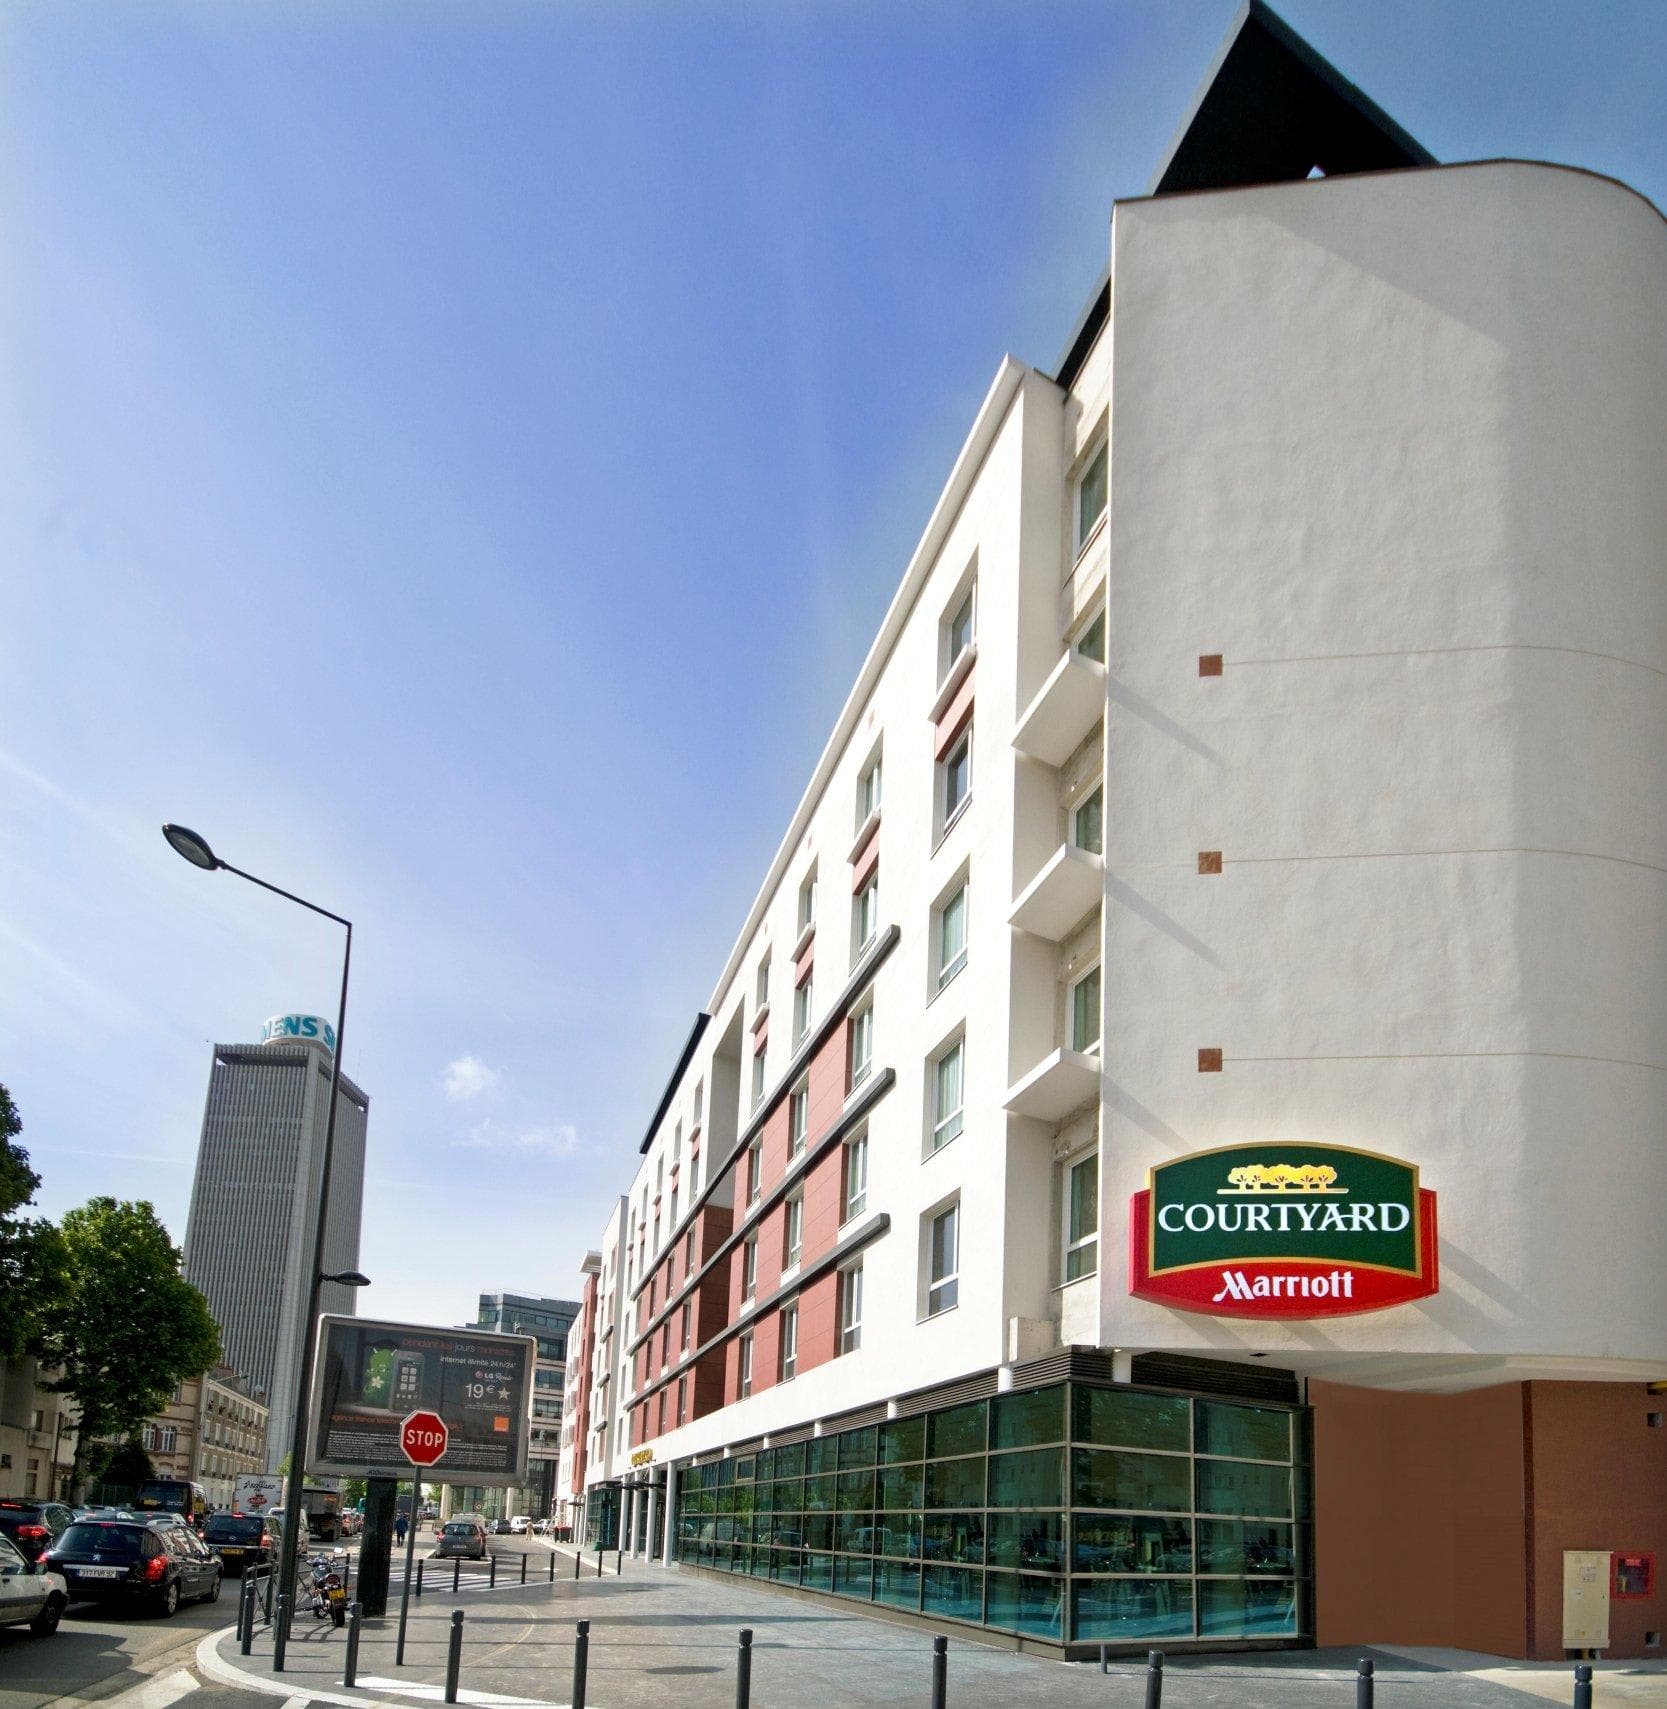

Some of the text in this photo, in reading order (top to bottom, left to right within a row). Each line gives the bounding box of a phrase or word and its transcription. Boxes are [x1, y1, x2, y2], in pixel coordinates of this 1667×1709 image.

[1158, 1203, 1410, 1232] COURTYARD
[1212, 1270, 1354, 1302] Marriott
[465, 1383, 484, 1399] 19
[406, 1429, 443, 1448] STOP
